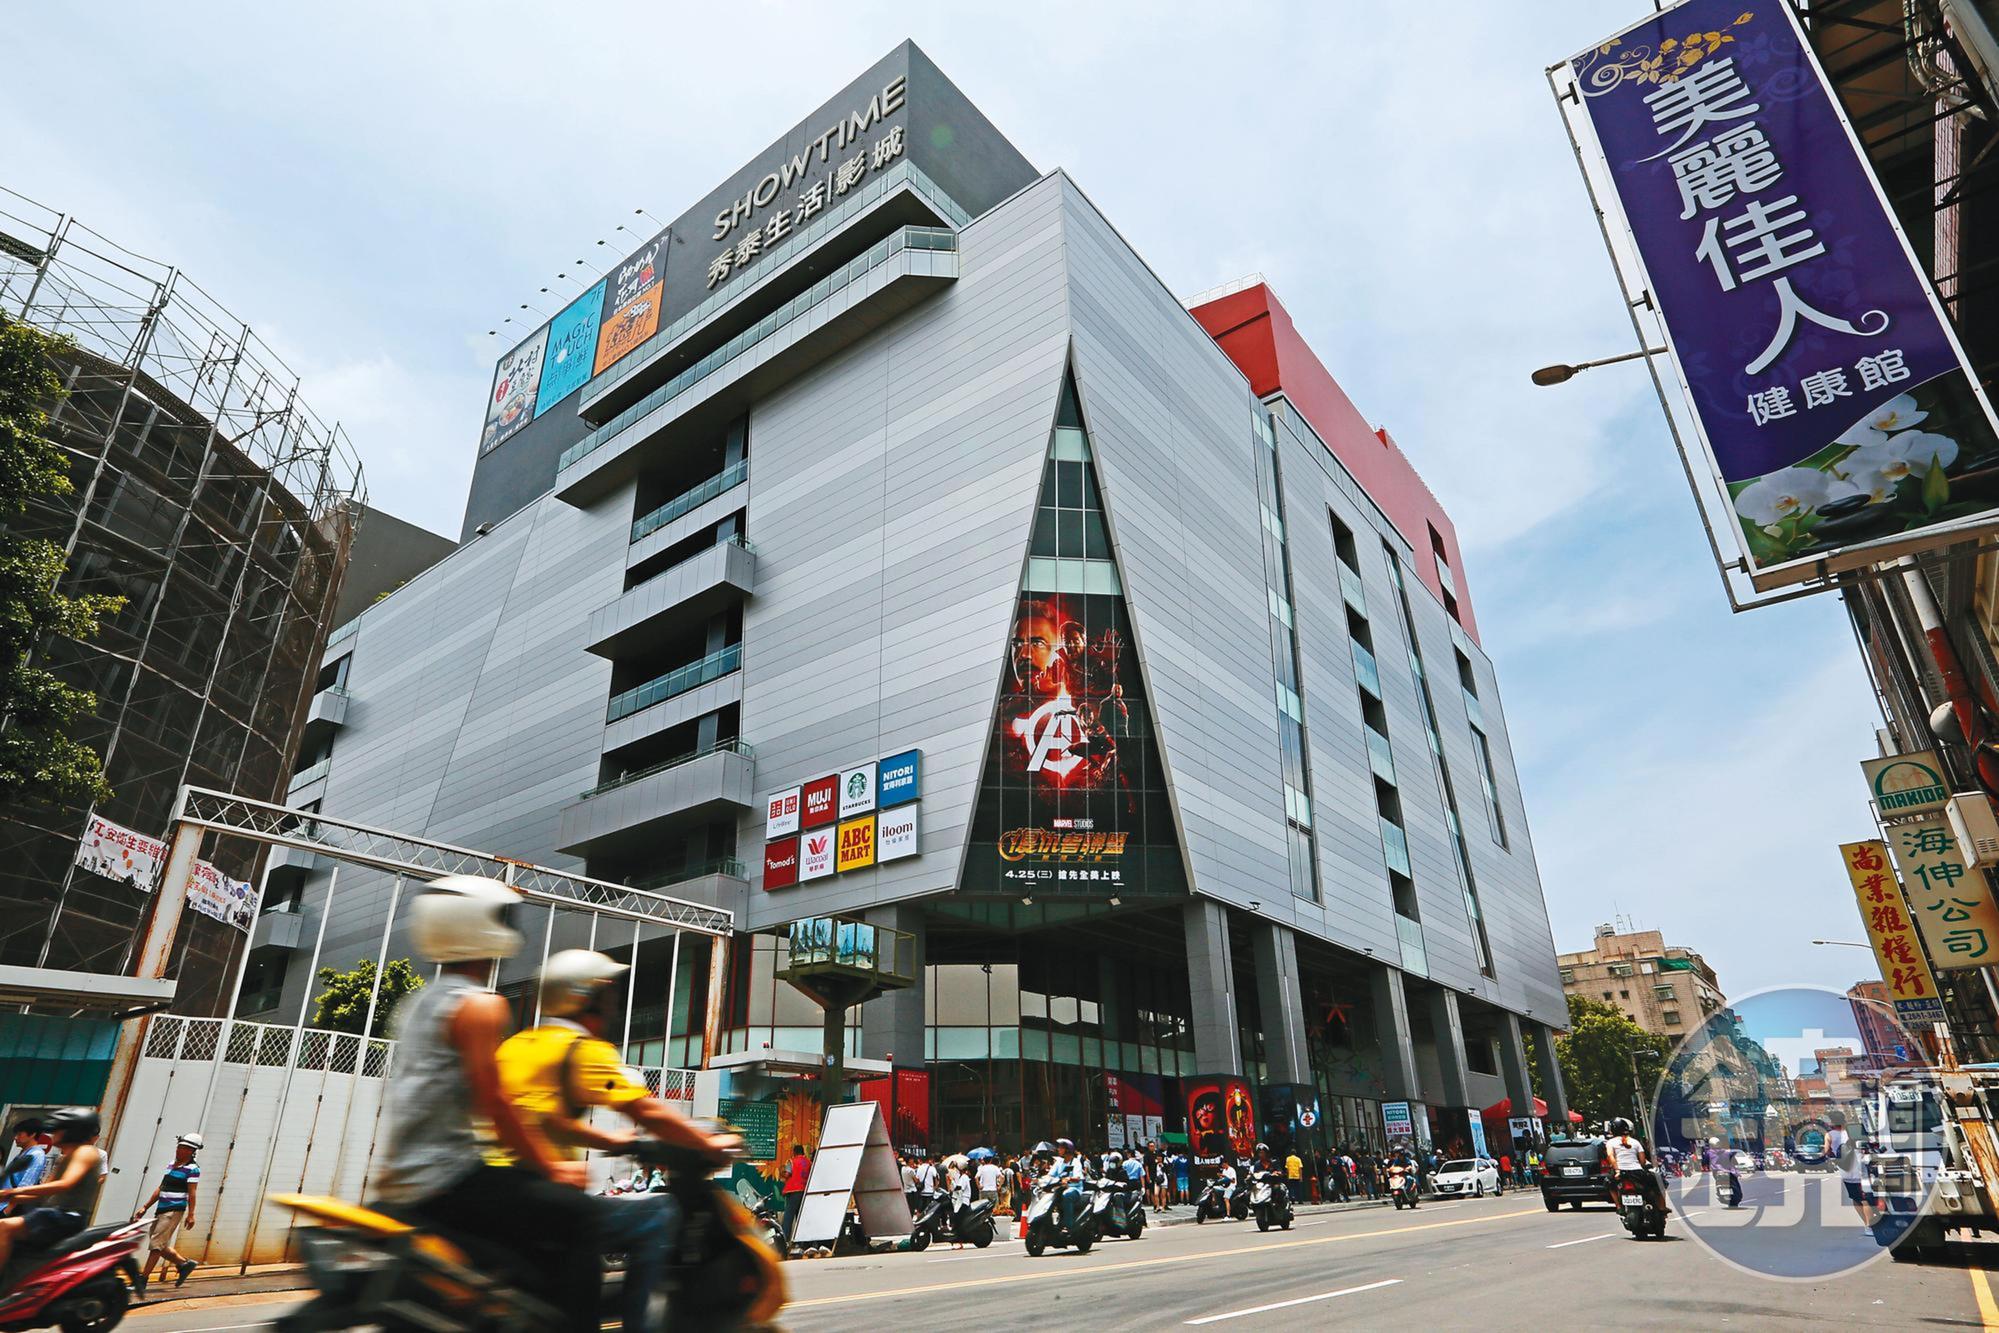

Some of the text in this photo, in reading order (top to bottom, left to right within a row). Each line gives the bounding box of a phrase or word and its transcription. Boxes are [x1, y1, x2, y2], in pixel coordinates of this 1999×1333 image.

[712, 75, 907, 241] SHOWTIME
[1636, 57, 1890, 376] 美麗佳人
[590, 286, 604, 306] 7F
[1747, 348, 1912, 428] 健康館
[883, 765, 913, 782] NITORI
[807, 787, 831, 807] MUJI
[842, 799, 871, 811] STARBUCKS
[1878, 784, 1948, 811] MAKIDA
[882, 822, 913, 838] iloom
[1053, 818, 1094, 829] MARVEL STUDIOS
[841, 824, 870, 848] ABC
[1005, 827, 1129, 856] 復仇者聯盟
[840, 845, 870, 863] MART
[1902, 826, 1989, 959] 海伸公司
[1850, 844, 1925, 997] 尚業雜糧行
